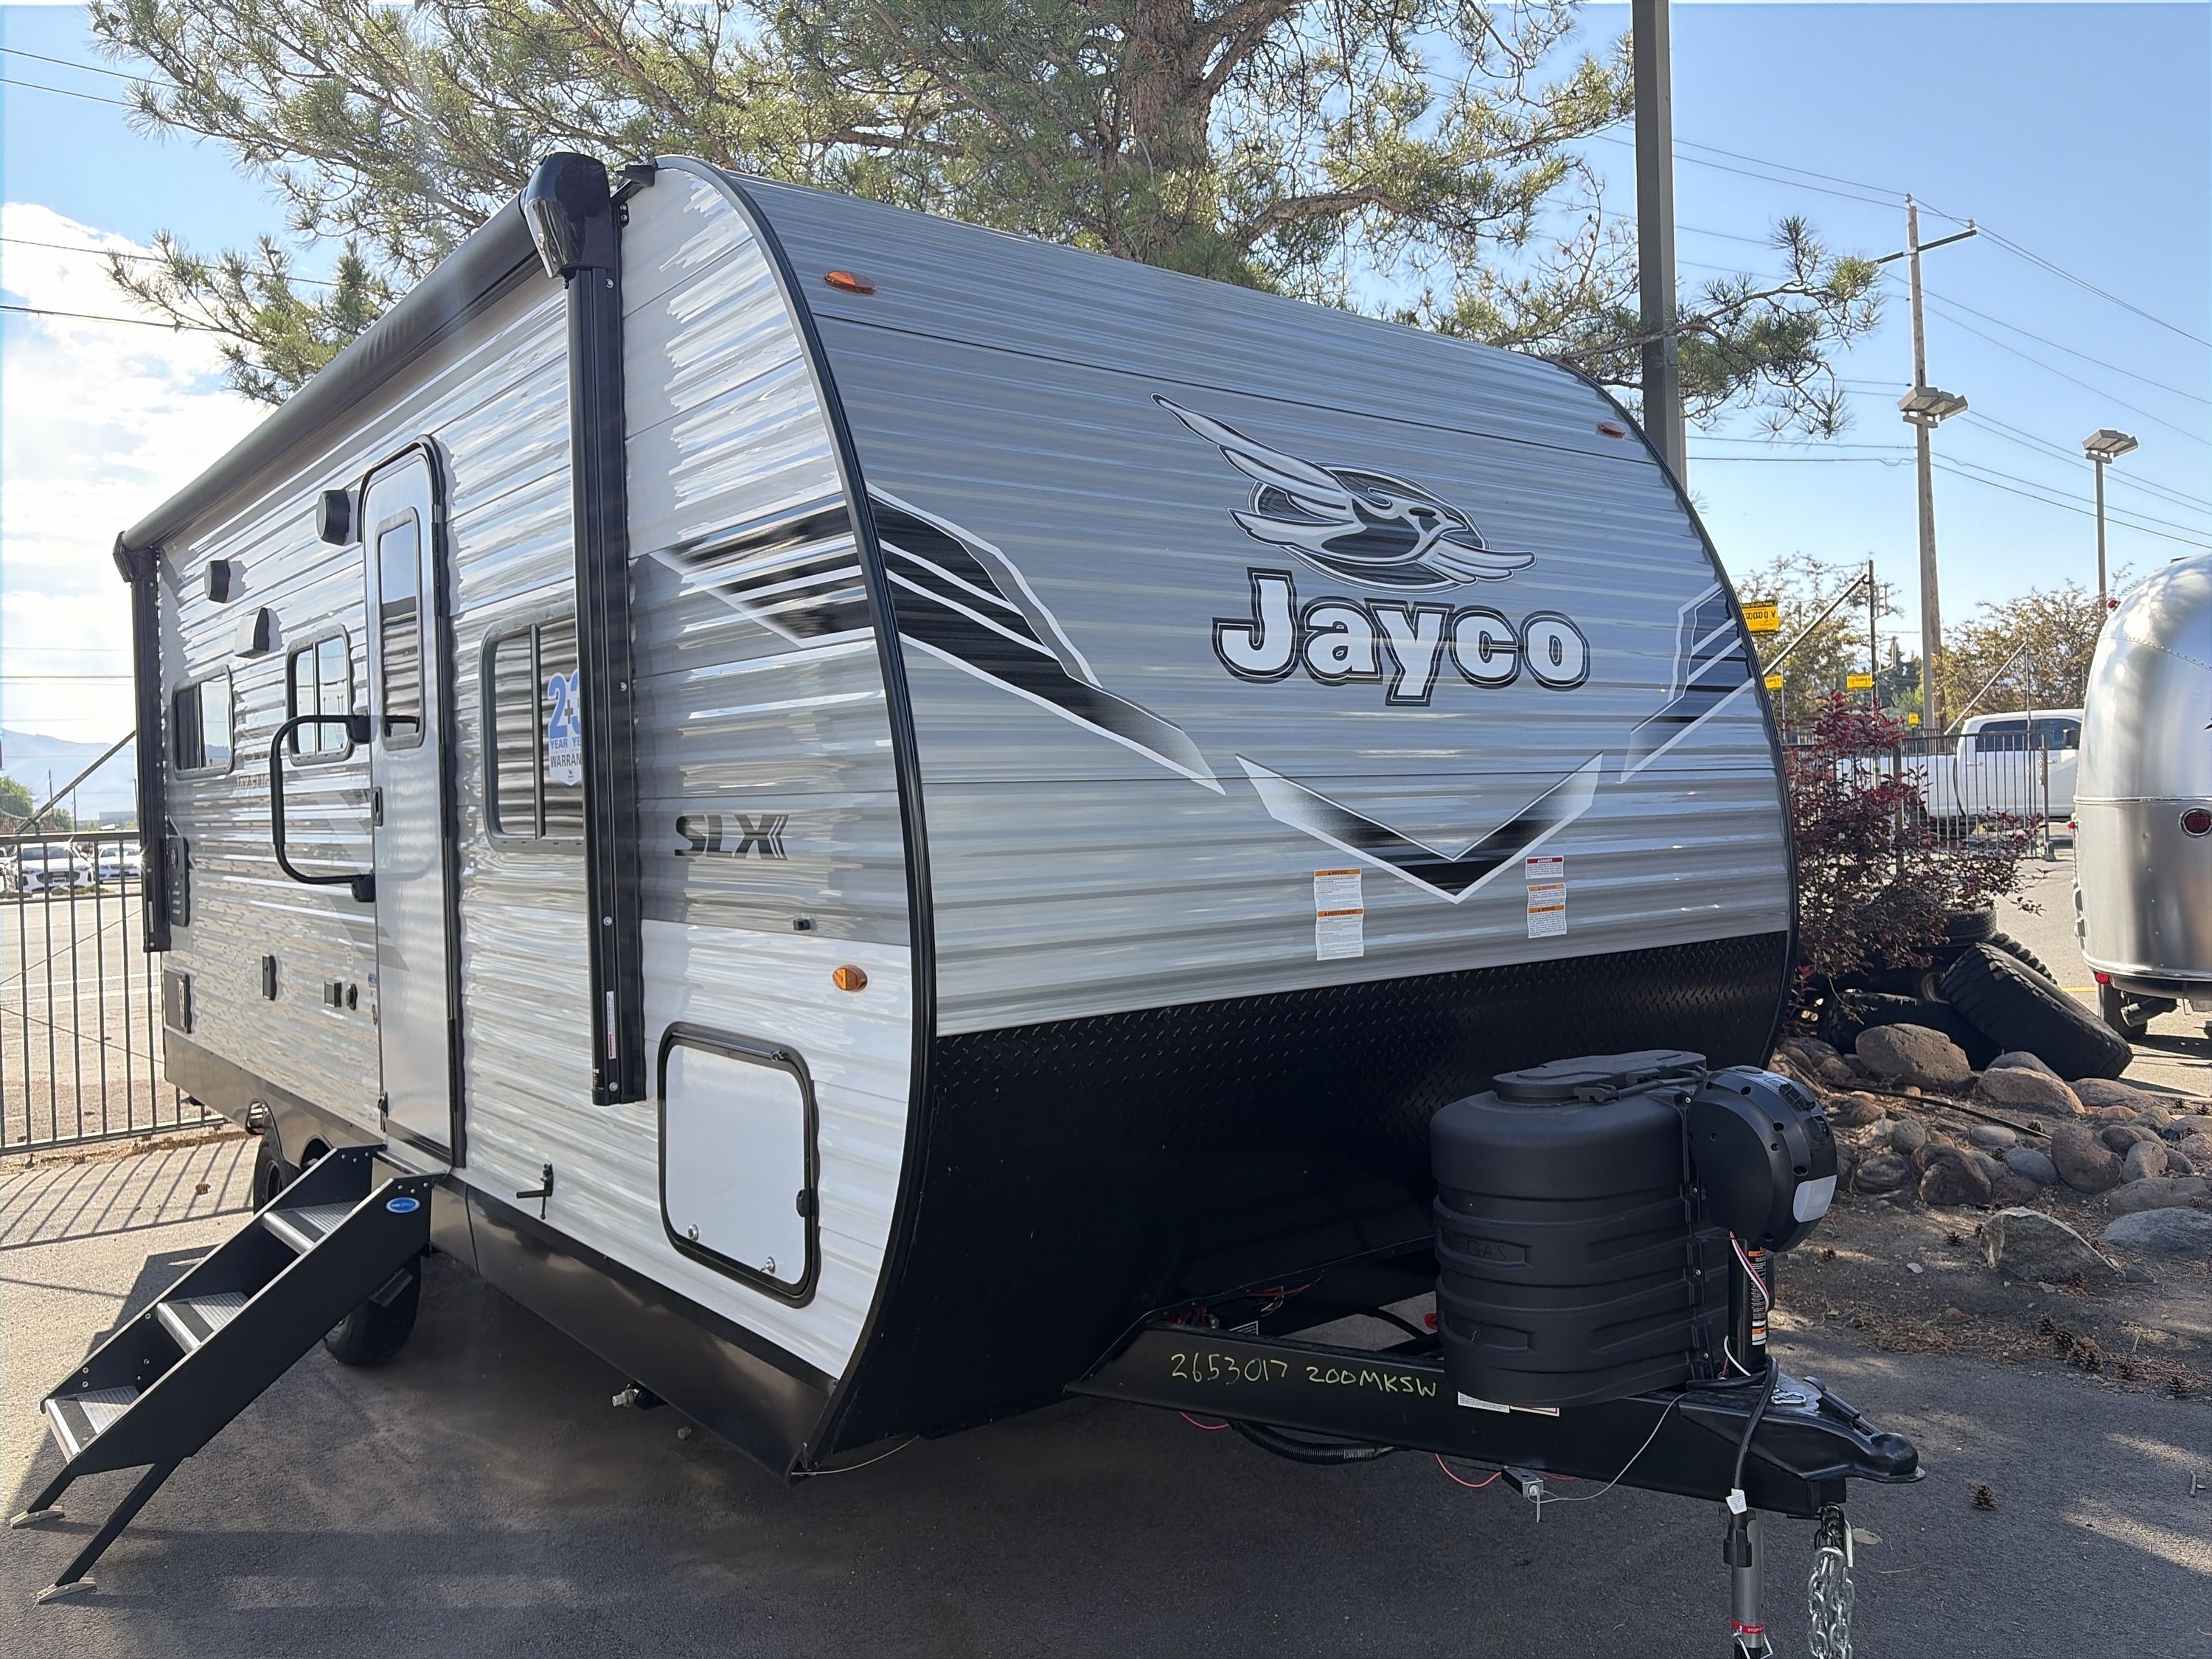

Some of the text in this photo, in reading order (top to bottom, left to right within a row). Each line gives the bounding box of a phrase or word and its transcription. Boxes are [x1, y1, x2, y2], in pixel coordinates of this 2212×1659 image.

[1212, 567, 1590, 706] Jayco
[549, 737, 581, 749] YEAR YE
[550, 753, 582, 768] WARRAN
[675, 814, 790, 860] SLX
[1467, 1239, 1507, 1262] GAS
[1170, 1352, 1288, 1385] 2653017
